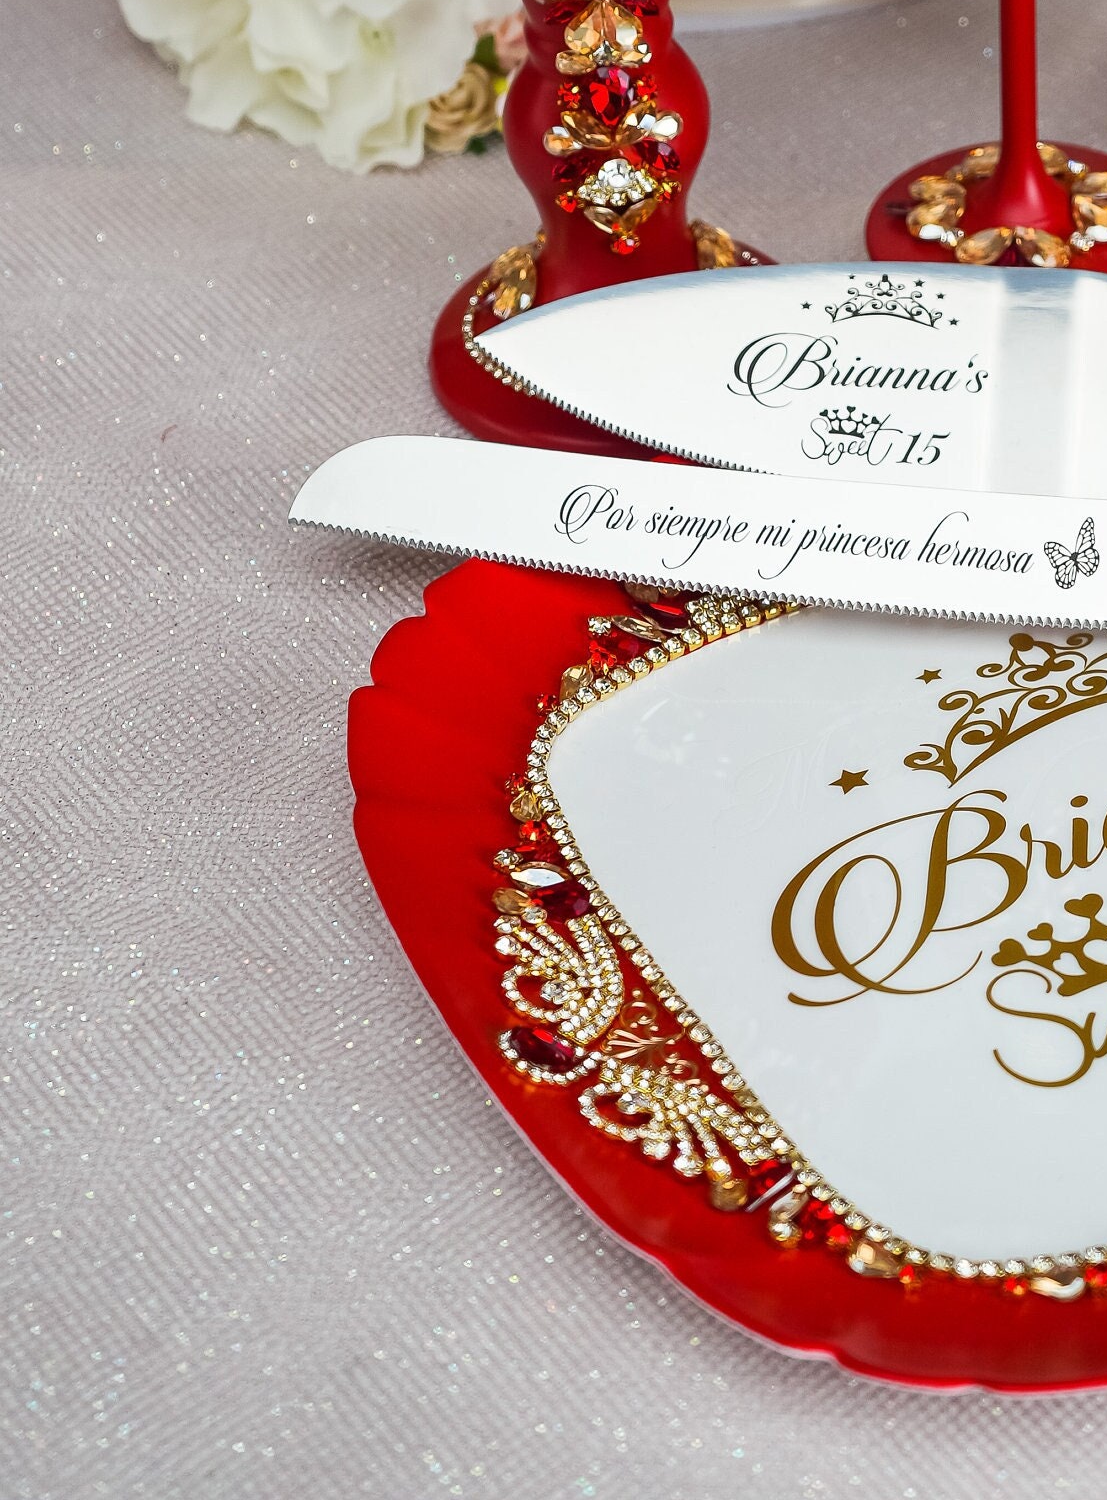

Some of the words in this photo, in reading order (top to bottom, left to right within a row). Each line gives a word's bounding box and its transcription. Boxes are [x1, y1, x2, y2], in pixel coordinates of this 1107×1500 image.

[727, 332, 989, 408] Brianna's
[801, 414, 903, 465] Sweet
[896, 432, 950, 465] 15
[554, 484, 638, 543] Por
[645, 506, 750, 569] siempre
[756, 518, 793, 546] mi
[916, 511, 1035, 574] hermosa
[757, 527, 912, 580] princesa
